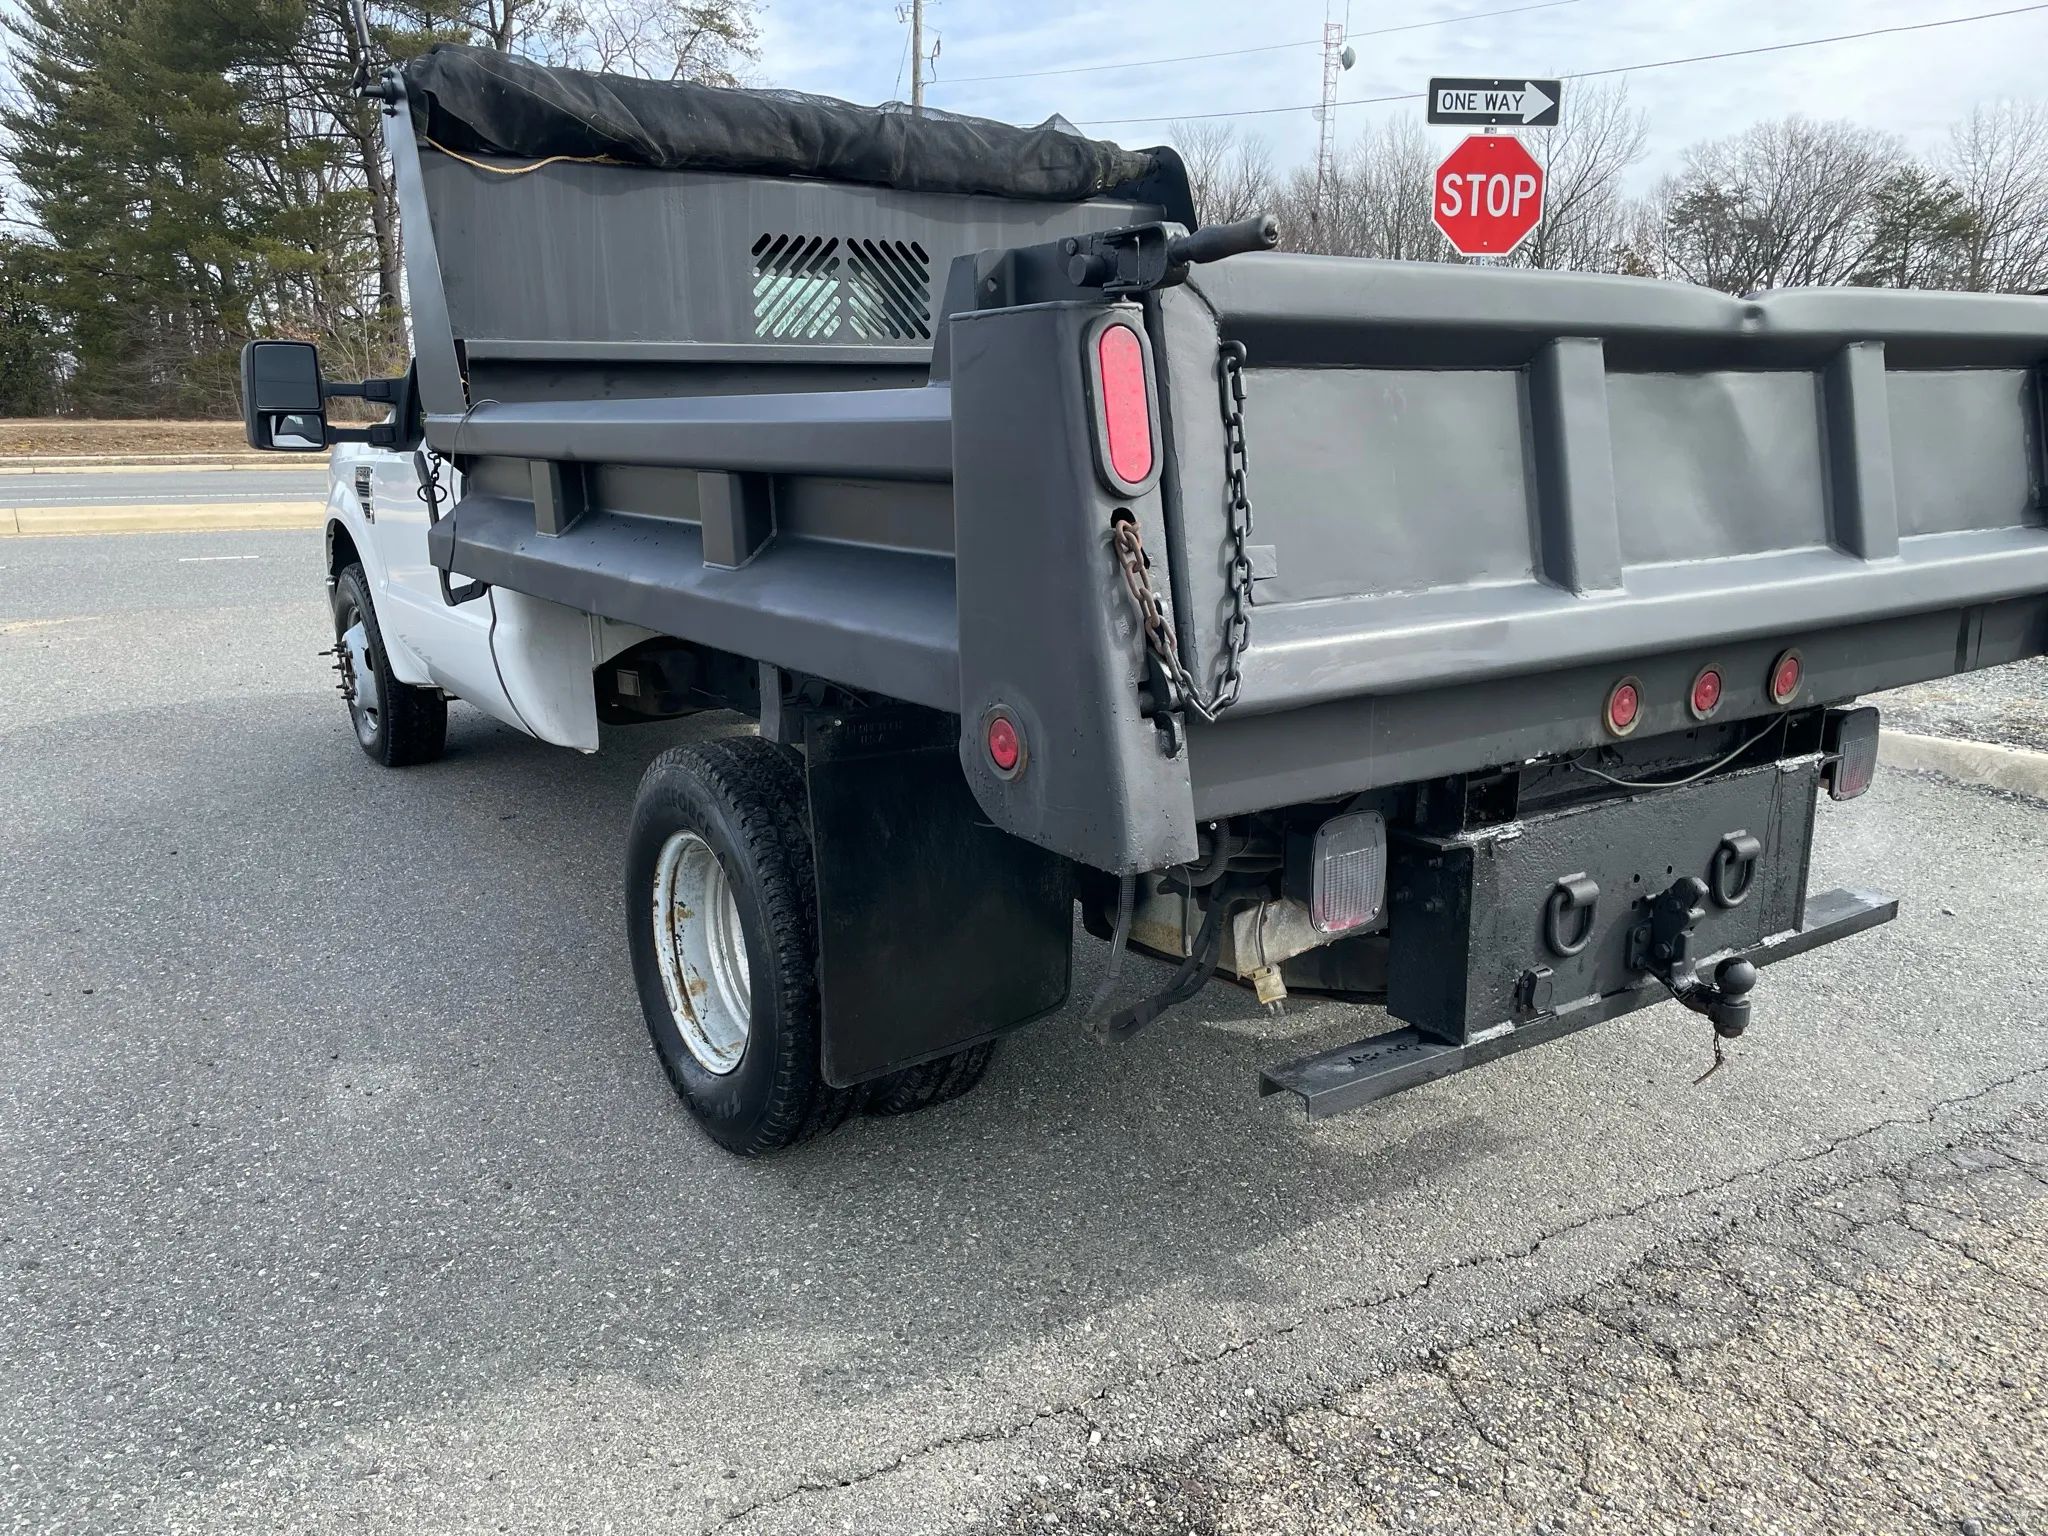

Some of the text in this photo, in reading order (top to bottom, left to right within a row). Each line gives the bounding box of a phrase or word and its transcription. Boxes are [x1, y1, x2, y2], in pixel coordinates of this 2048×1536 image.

[1442, 92, 1524, 112] ONE WAY
[1440, 173, 1537, 218] STOP
